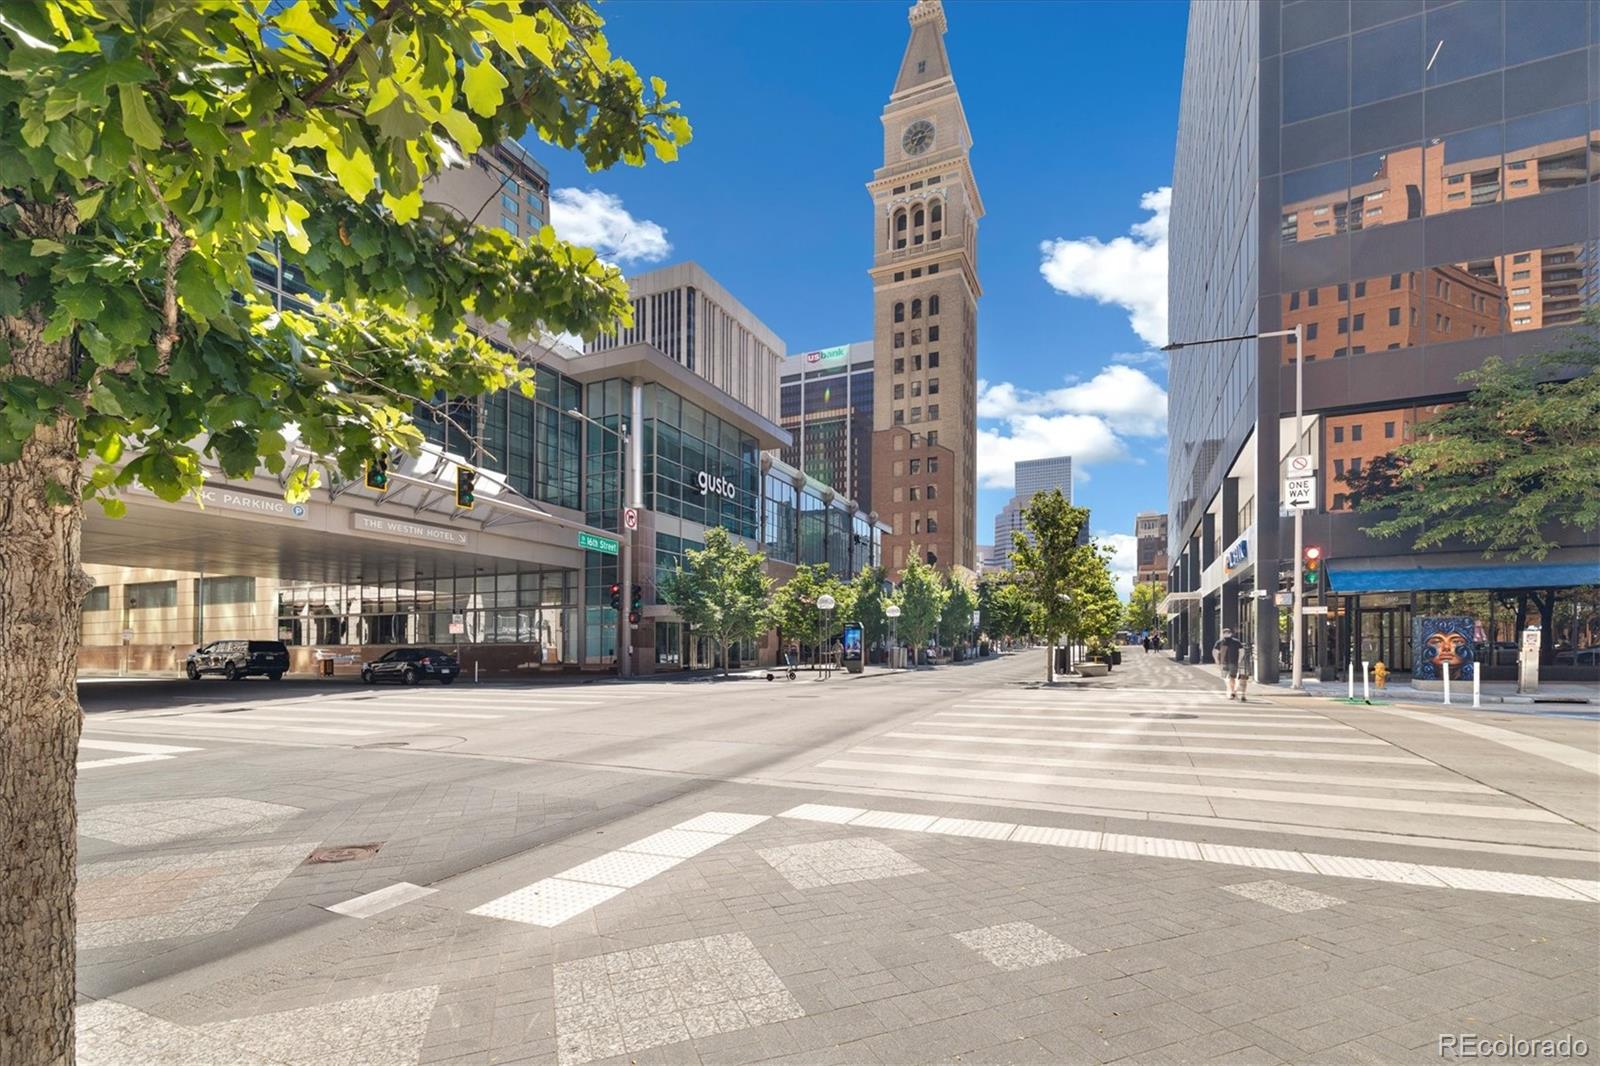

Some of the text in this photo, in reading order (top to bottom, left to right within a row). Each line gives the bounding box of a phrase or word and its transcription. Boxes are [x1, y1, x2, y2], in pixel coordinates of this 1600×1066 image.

[821, 348, 845, 359] bank
[698, 471, 736, 499] gusto
[1288, 480, 1310, 490] ONE
[1289, 489, 1310, 498] WAY
[223, 494, 284, 513] PARKING
[363, 518, 455, 541] THE WESTIN HOTEL
[586, 536, 599, 548] 16th
[599, 540, 617, 552] Street
